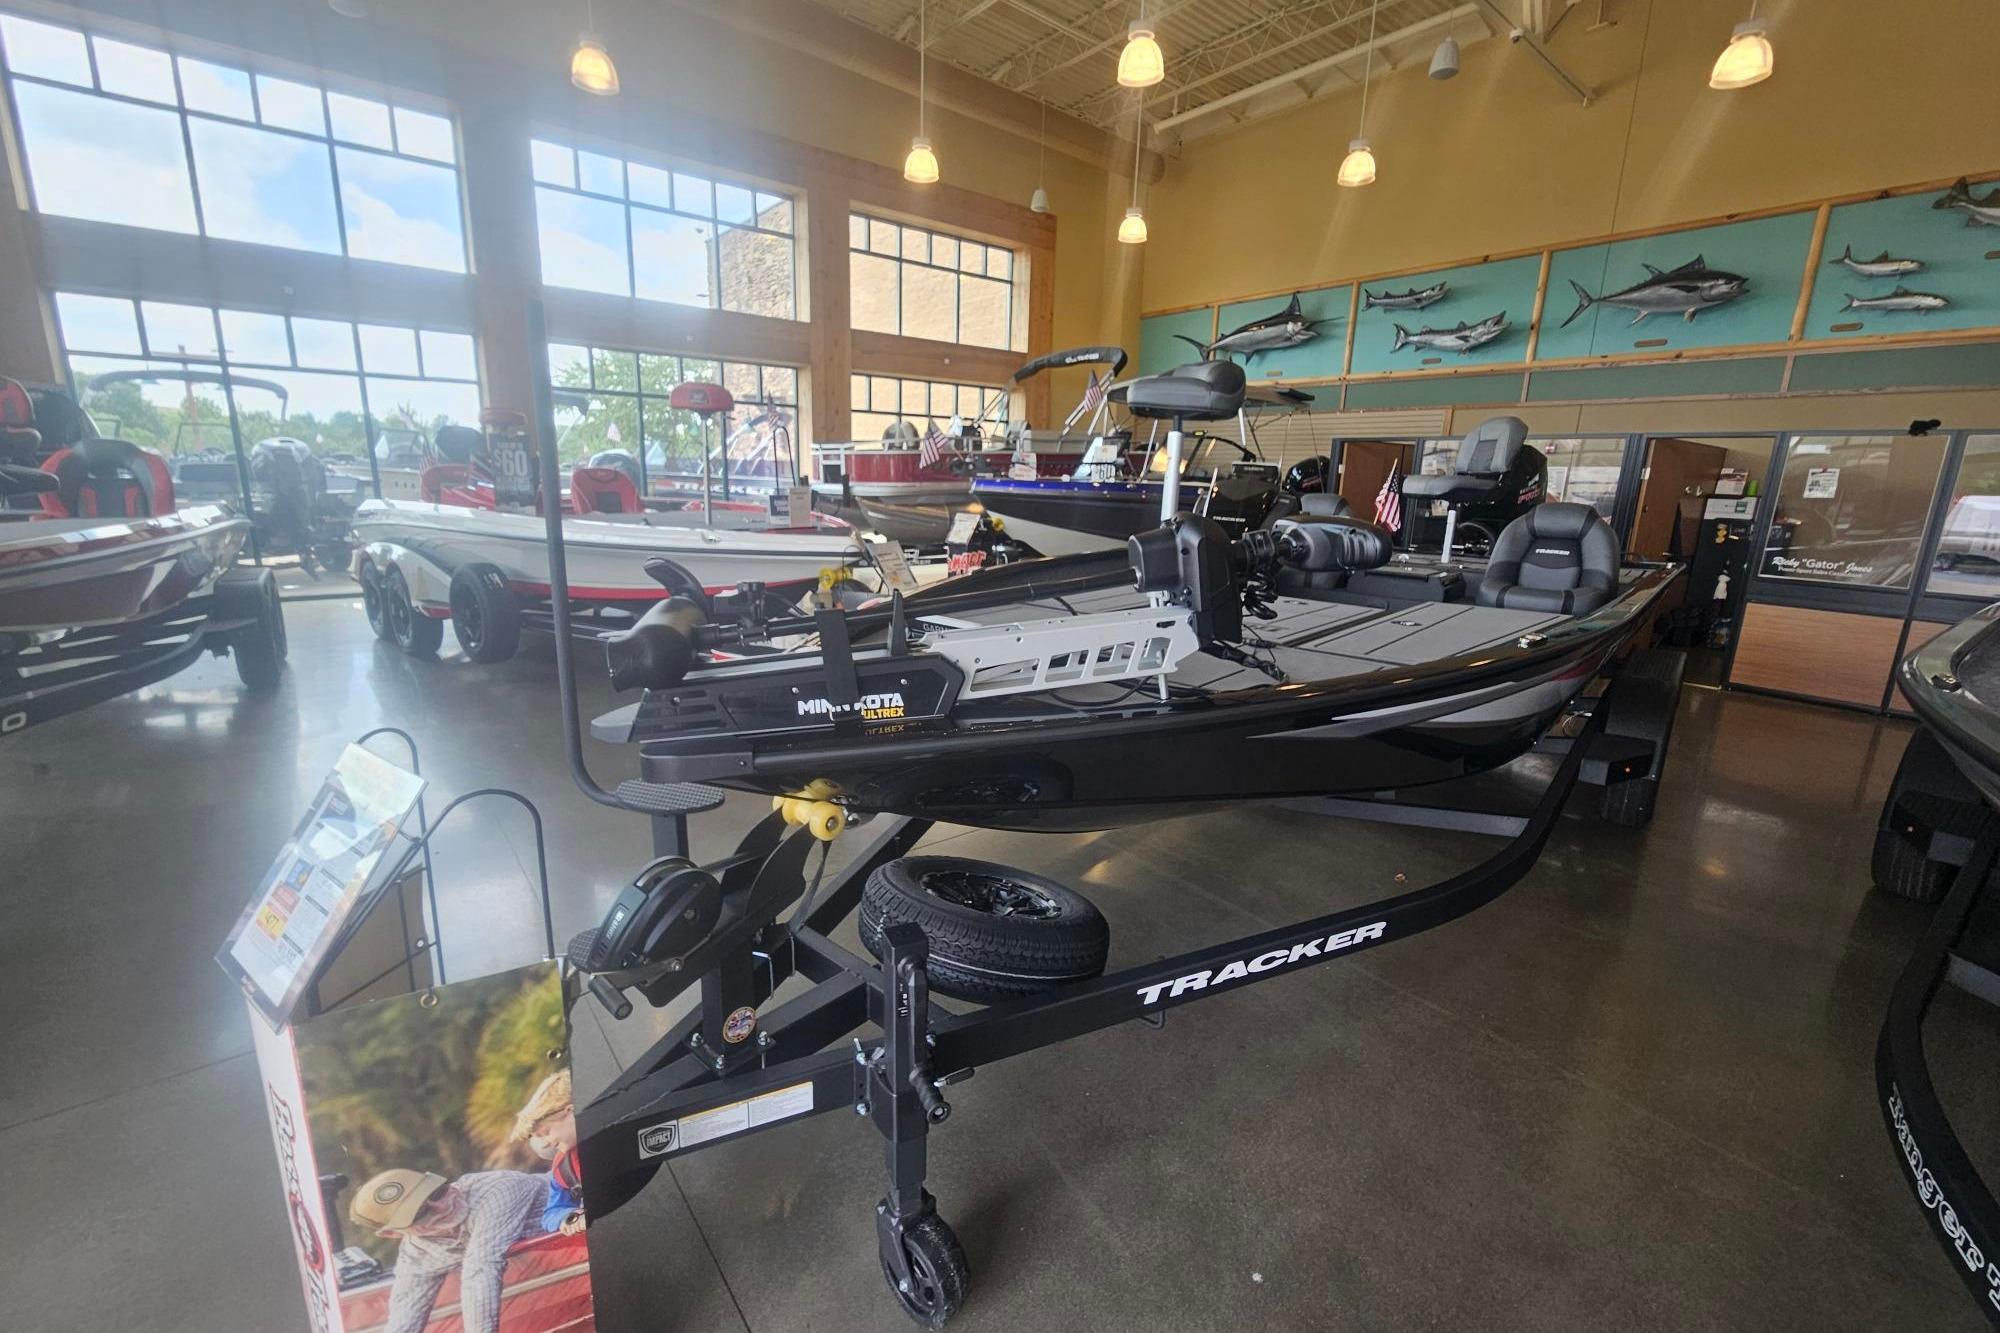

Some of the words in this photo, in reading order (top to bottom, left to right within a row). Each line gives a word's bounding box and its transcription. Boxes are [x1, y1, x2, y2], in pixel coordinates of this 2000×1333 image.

[1802, 558, 1845, 570] "Gator"
[863, 707, 904, 719] ULTREX
[1136, 921, 1387, 1005] TRACKER
[646, 1131, 672, 1147] IMPACT
[1888, 1081, 1985, 1273] Ranger
